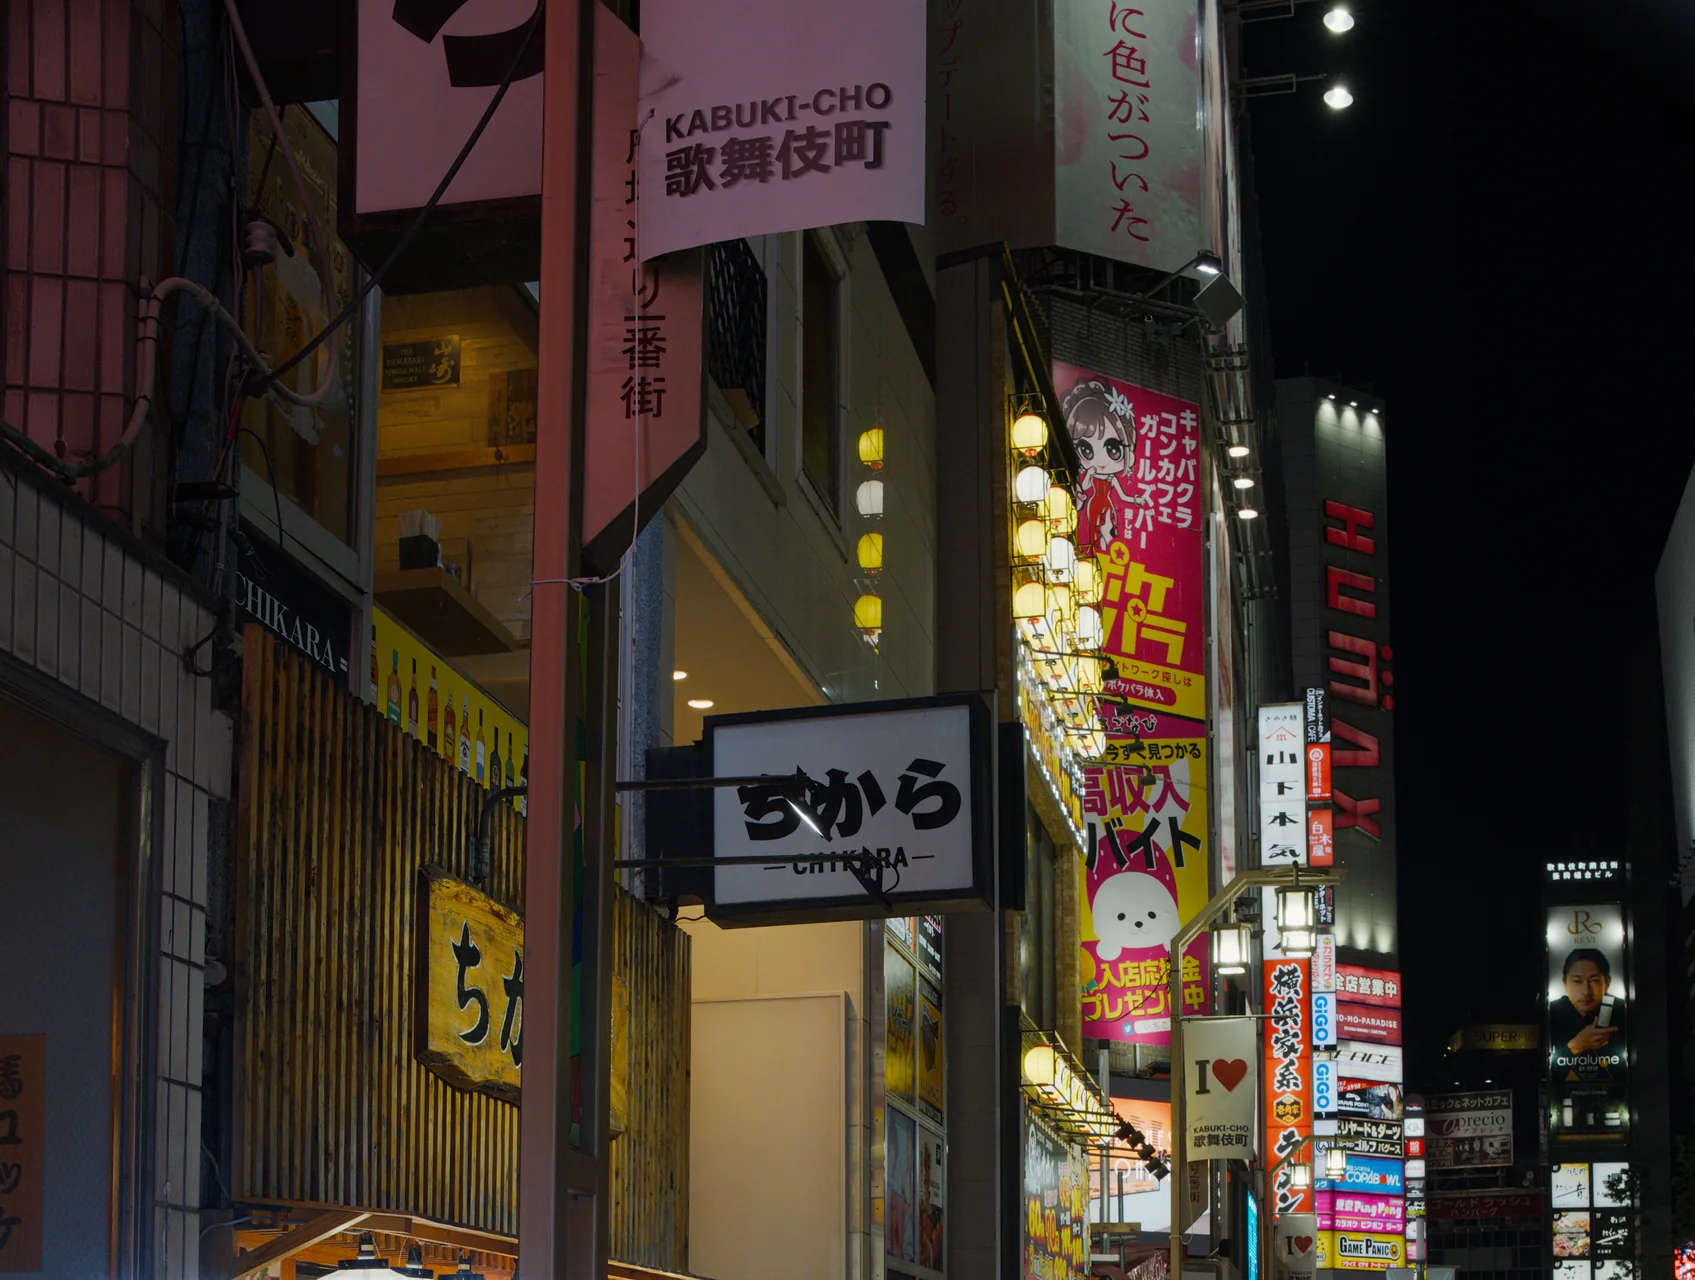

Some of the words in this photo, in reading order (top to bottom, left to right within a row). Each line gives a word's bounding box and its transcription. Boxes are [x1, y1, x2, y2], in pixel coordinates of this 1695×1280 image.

[665, 82, 892, 143] KABUKI-CHO
[1103, 0, 1150, 242] に色がついた
[664, 119, 890, 198] 歌舞伎町
[1134, 414, 1160, 549] ガールズバー
[1157, 412, 1178, 523] コンカフェ
[1176, 408, 1198, 529] キャバクラ
[1306, 724, 1316, 743] CAFE
[1085, 816, 1202, 873] バイト
[1271, 962, 1304, 1092] 横浜家系
[1314, 995, 1329, 1042] GiGO
[1195, 1059, 1211, 1095] I
[1557, 1053, 1620, 1067] auralume
[1316, 1063, 1330, 1109] GiGO
[1193, 1125, 1249, 1135] KABUKI-CHO
[1193, 1134, 1249, 1148] 歌舞伎町
[1338, 1121, 1401, 1140] リヤード&ダーツ
[1335, 1219, 1358, 1229] カラオケ
[1354, 1199, 1377, 1217] Ping
[1286, 1235, 1294, 1254] I
[1340, 1236, 1363, 1254] GAME
[1365, 1238, 1389, 1256] PANIC
